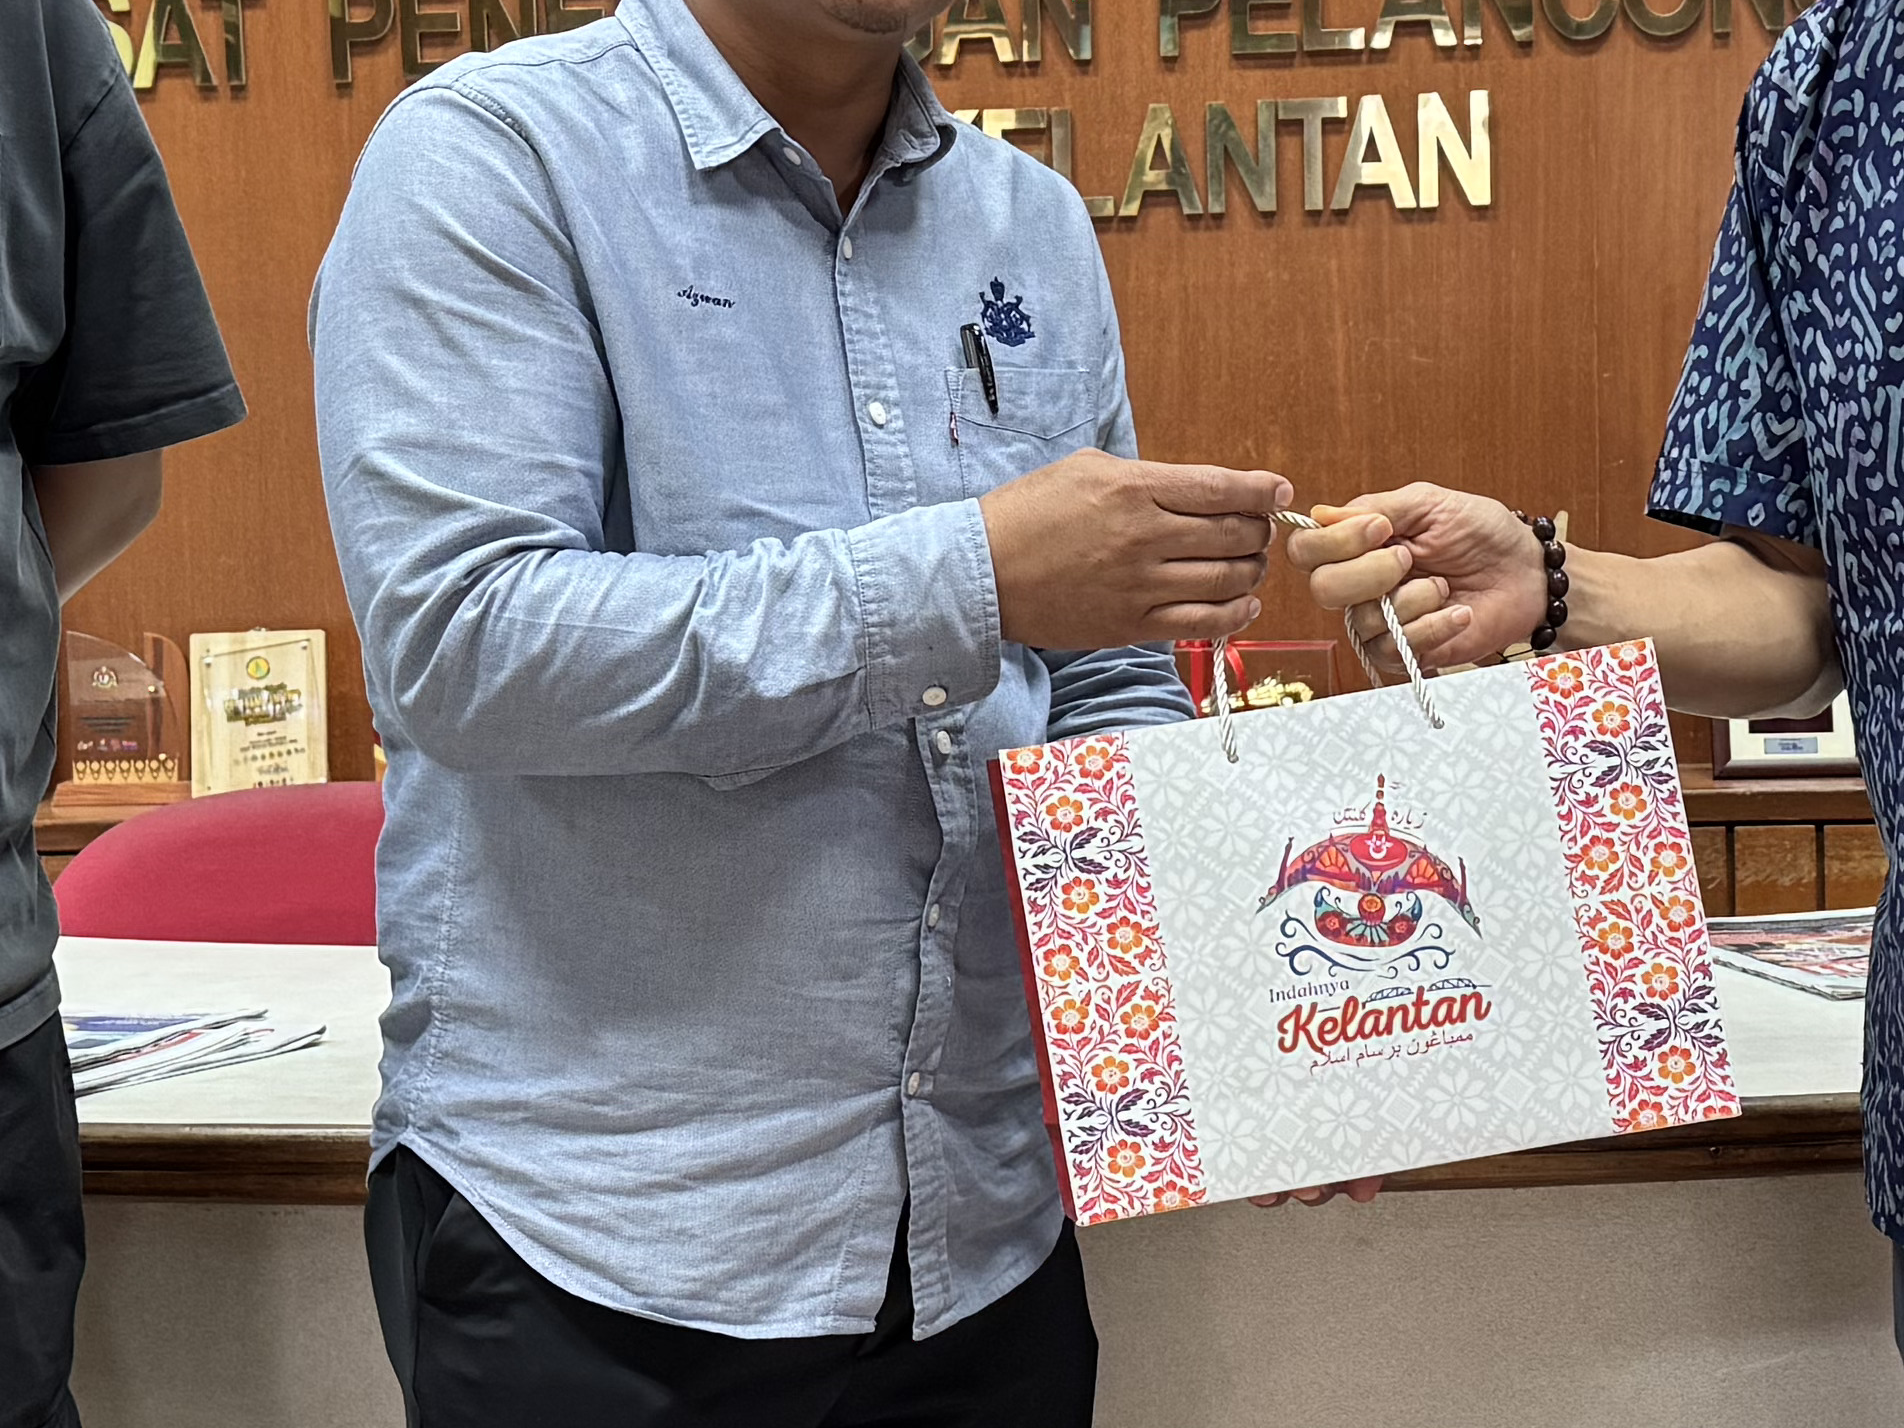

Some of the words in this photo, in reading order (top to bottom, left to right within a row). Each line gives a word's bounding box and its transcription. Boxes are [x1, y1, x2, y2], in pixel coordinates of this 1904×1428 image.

[953, 89, 1491, 217] ELANTAN
[1268, 979, 1350, 1003] Indahnya
[1276, 985, 1492, 1055] Kelantan
